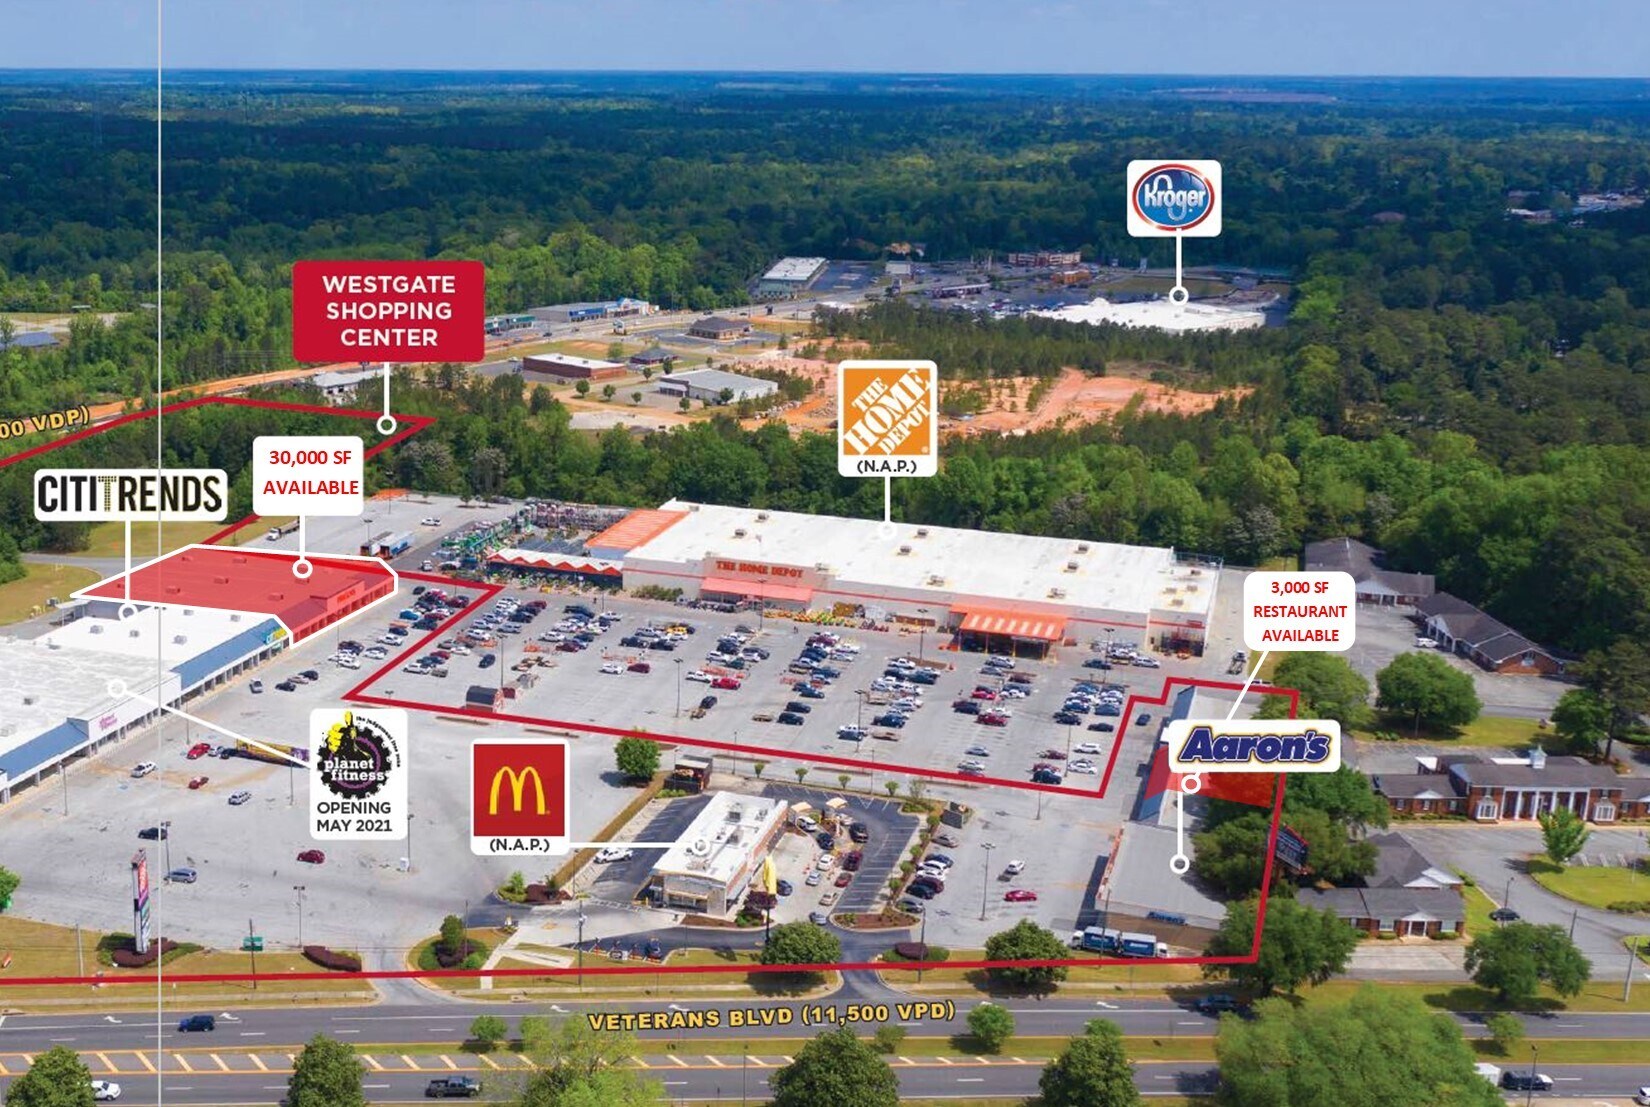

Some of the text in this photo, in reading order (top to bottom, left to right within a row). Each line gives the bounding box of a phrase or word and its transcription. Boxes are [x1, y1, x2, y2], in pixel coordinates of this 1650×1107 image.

[716, 560, 804, 578] THE HOME DEPOT
